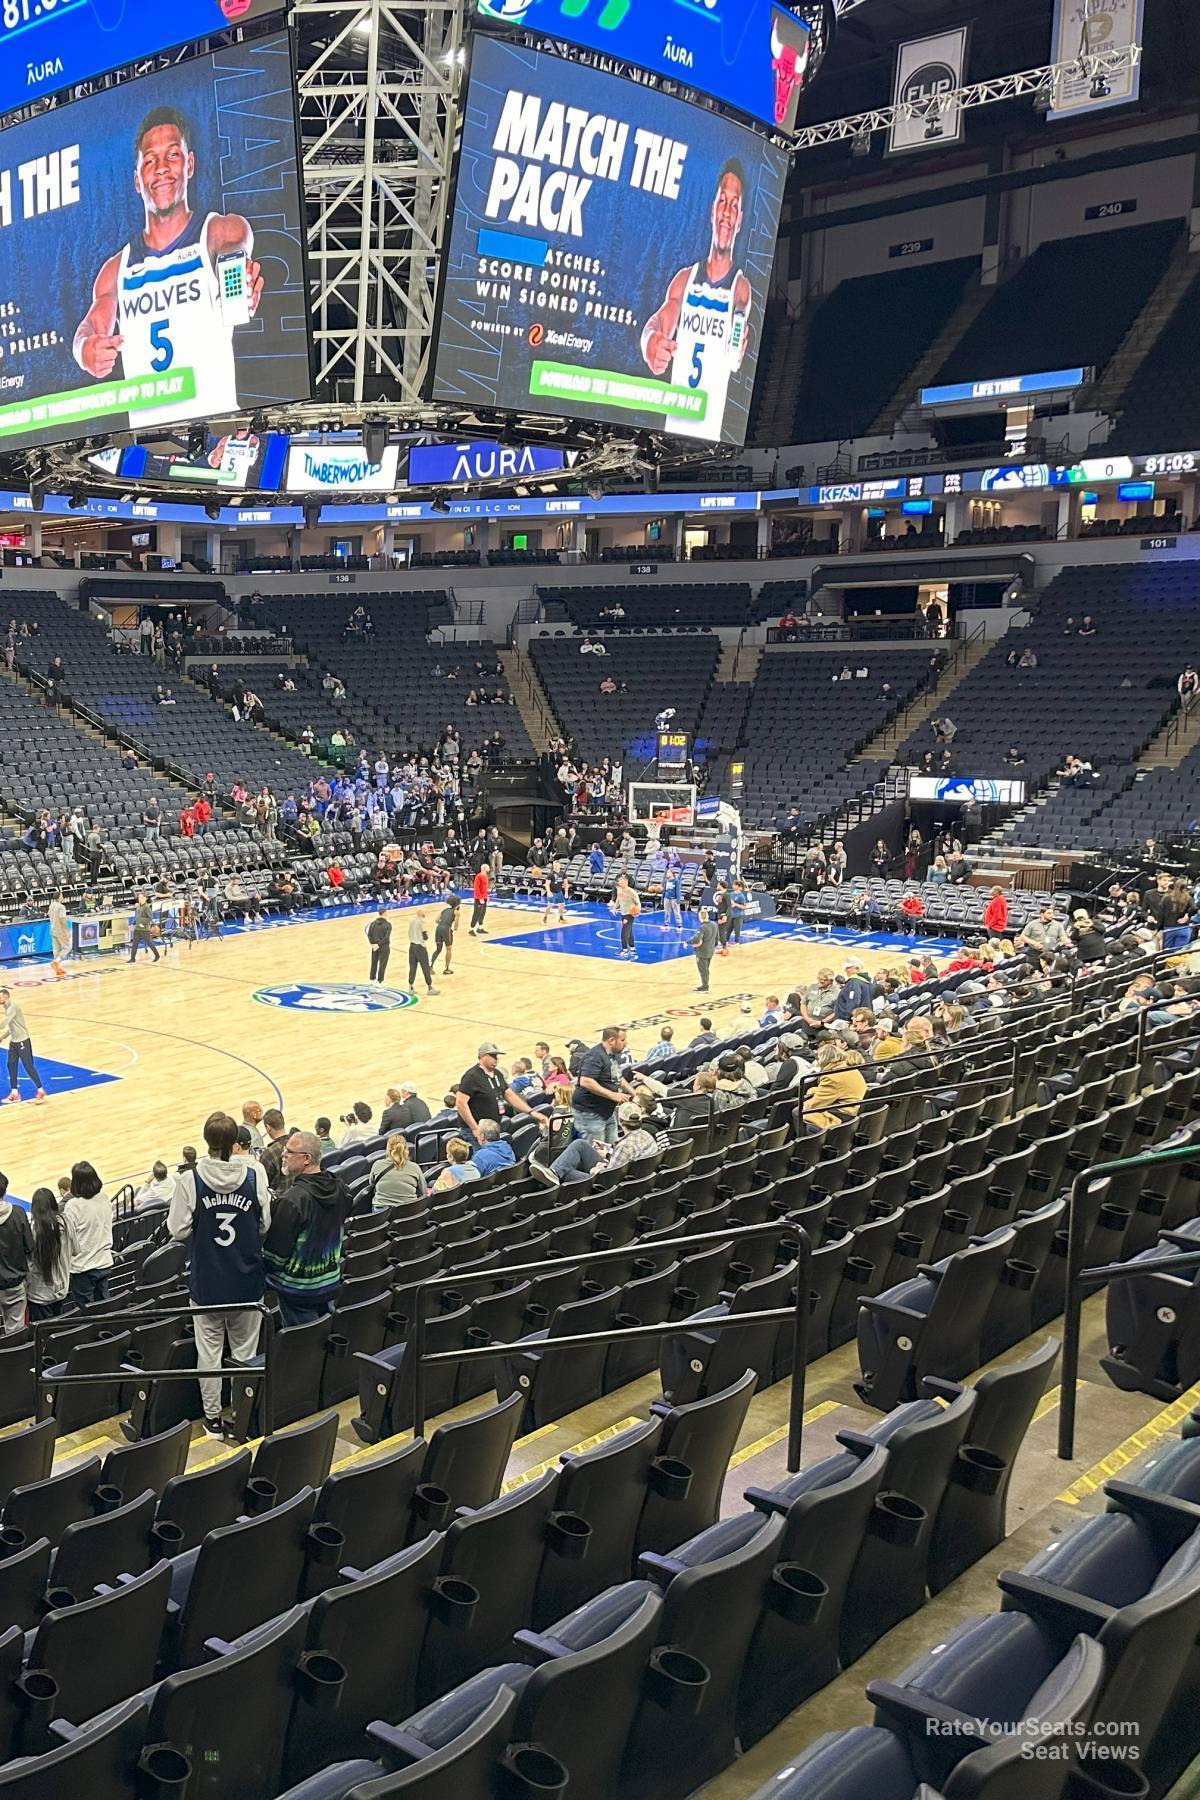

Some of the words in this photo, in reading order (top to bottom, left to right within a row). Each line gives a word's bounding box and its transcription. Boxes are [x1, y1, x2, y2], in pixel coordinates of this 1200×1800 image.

[907, 78, 950, 104] FLIP
[492, 89, 630, 182] MATCH
[630, 128, 688, 200] THE
[18, 143, 81, 219] THE
[485, 156, 593, 237] PACK
[1098, 202, 1122, 217] 240
[900, 241, 921, 254] 239
[478, 259, 533, 282] SCORE
[540, 270, 602, 297] POINTS.
[123, 279, 201, 319] WOLVES
[476, 281, 511, 300] WIN
[519, 288, 578, 313] SIGNED
[584, 301, 638, 326] PRIZES.
[470, 320, 511, 335] POWERED
[513, 327, 525, 337] BY
[682, 312, 725, 339] WOLVES
[10, 330, 64, 355] PRIZES.
[150, 318, 174, 372] 5
[688, 342, 705, 389] 5
[156, 376, 185, 399] PLAY
[1105, 464, 1114, 477] 0
[1144, 454, 1195, 472] 81:03
[820, 485, 860, 502] KFAN
[1149, 539, 1167, 549] 101
[18, 942, 36, 954] MOVE
[201, 1193, 253, 1212] McDANIELS
[214, 1212, 237, 1247] 3
